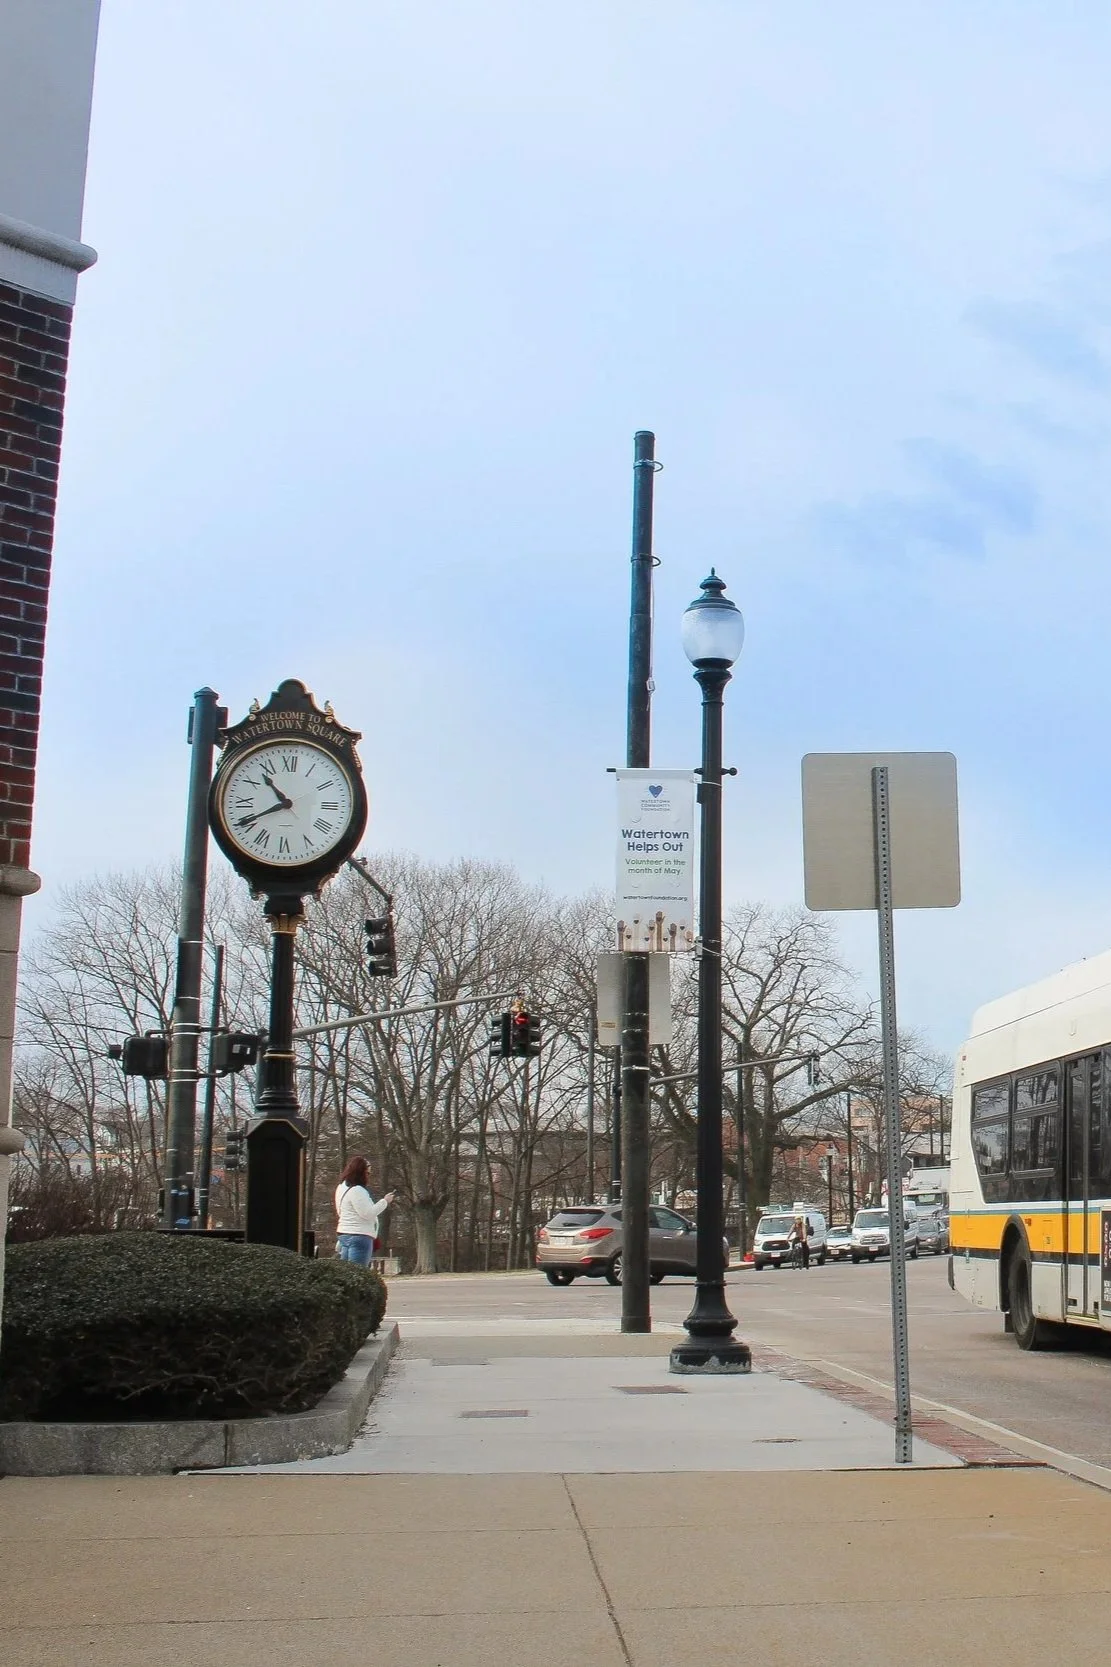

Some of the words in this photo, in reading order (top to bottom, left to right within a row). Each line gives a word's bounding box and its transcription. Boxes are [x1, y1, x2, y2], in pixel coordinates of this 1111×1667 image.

[260, 711, 305, 722] WELCOME
[308, 713, 321, 724] TO
[231, 719, 303, 744] WATERTOWN
[307, 721, 347, 747] SQUARE
[621, 829, 689, 839] Watertown
[627, 841, 660, 854] Helps
[662, 842, 683, 852] Out
[625, 858, 663, 866] Volunteer
[673, 858, 686, 866] the
[664, 867, 683, 876] May.
